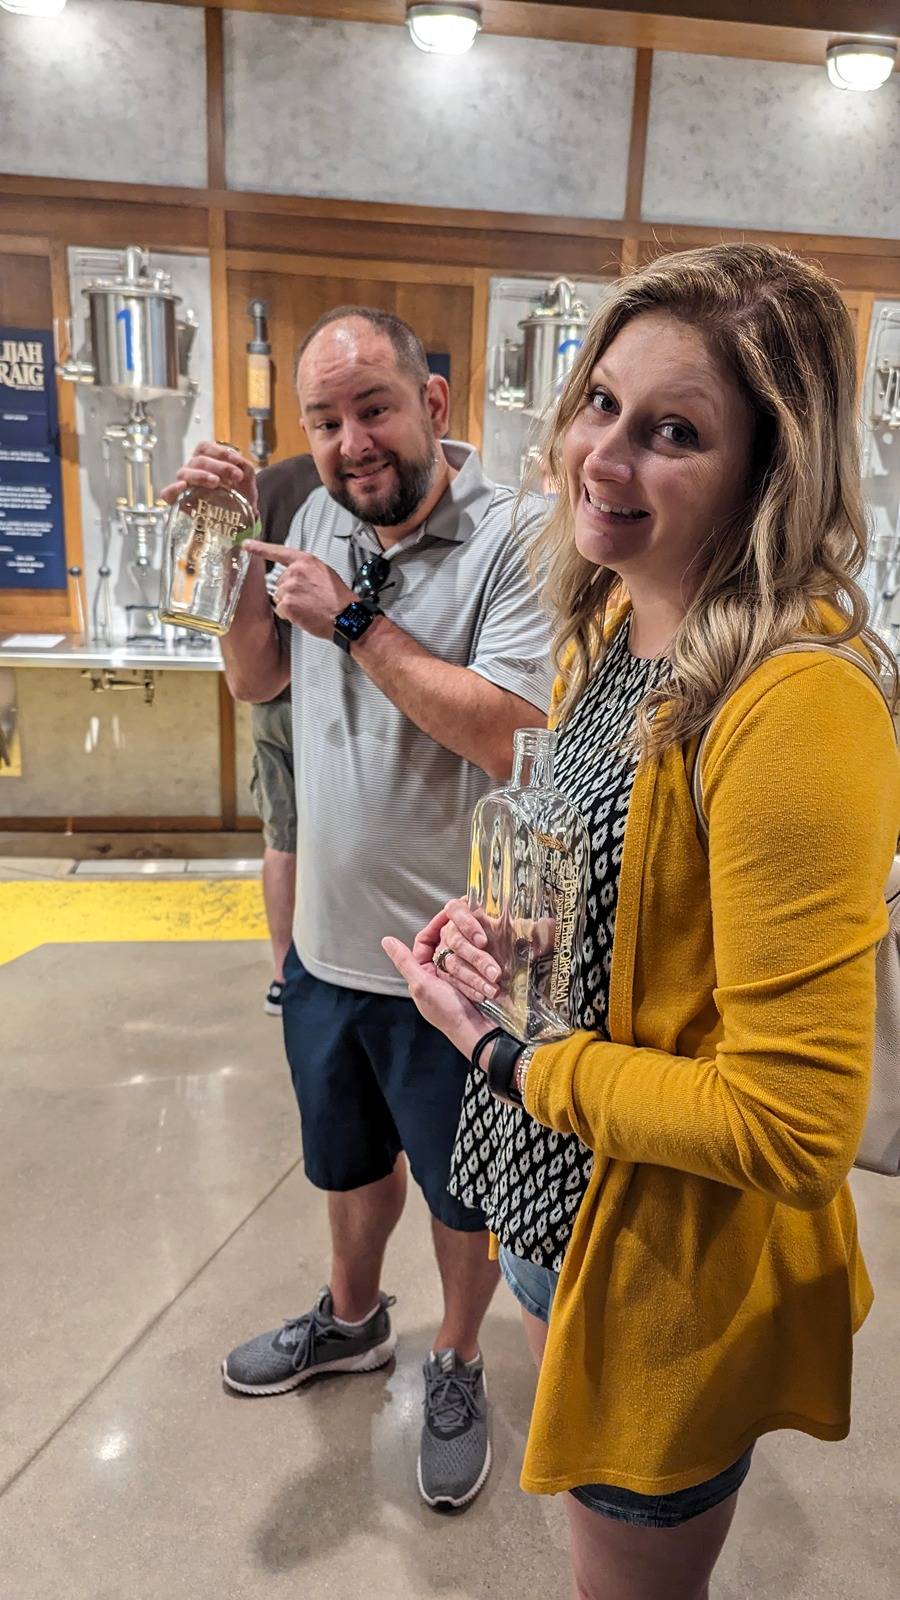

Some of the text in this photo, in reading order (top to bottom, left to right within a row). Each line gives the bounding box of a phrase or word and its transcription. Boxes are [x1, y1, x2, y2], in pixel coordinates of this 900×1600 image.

[0, 341, 43, 363] IJAH
[116, 308, 134, 371] 1
[197, 499, 241, 526] ELIJAH
[192, 514, 238, 541] CRAIG
[553, 949, 572, 1008] ORIGINAL
